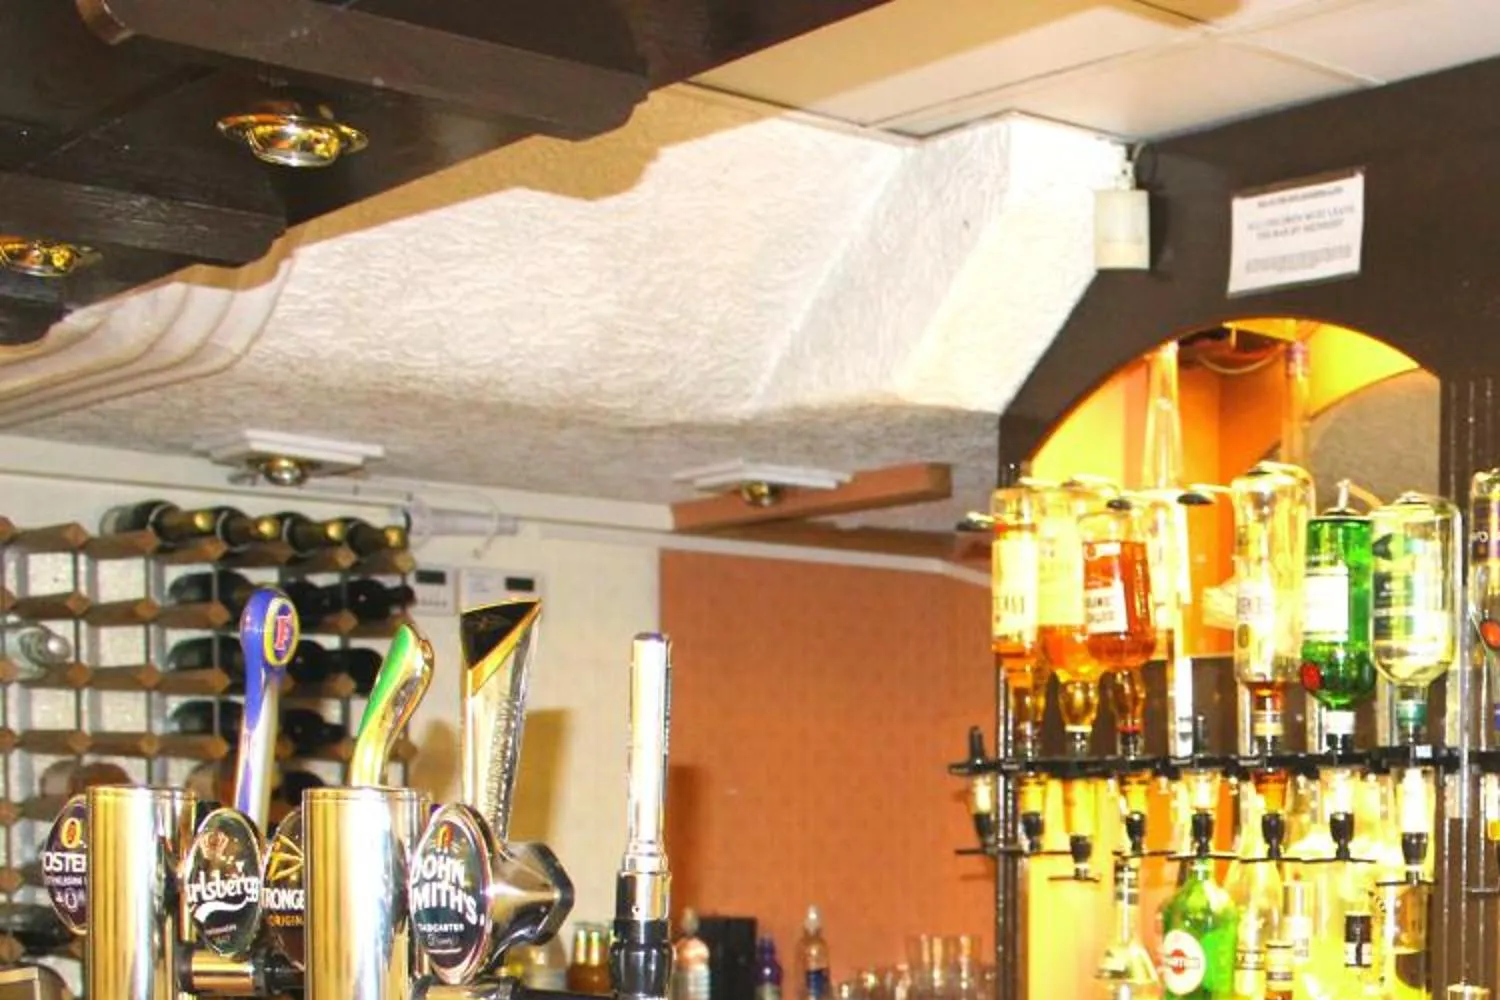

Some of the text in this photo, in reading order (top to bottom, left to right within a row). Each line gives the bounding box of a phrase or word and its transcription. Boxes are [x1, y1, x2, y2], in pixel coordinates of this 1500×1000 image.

[43, 851, 87, 873] OSTE
[412, 854, 467, 887] JOHN
[187, 870, 260, 902] arlsberg
[261, 887, 305, 909] TRONG
[413, 883, 478, 925] MITH'S
